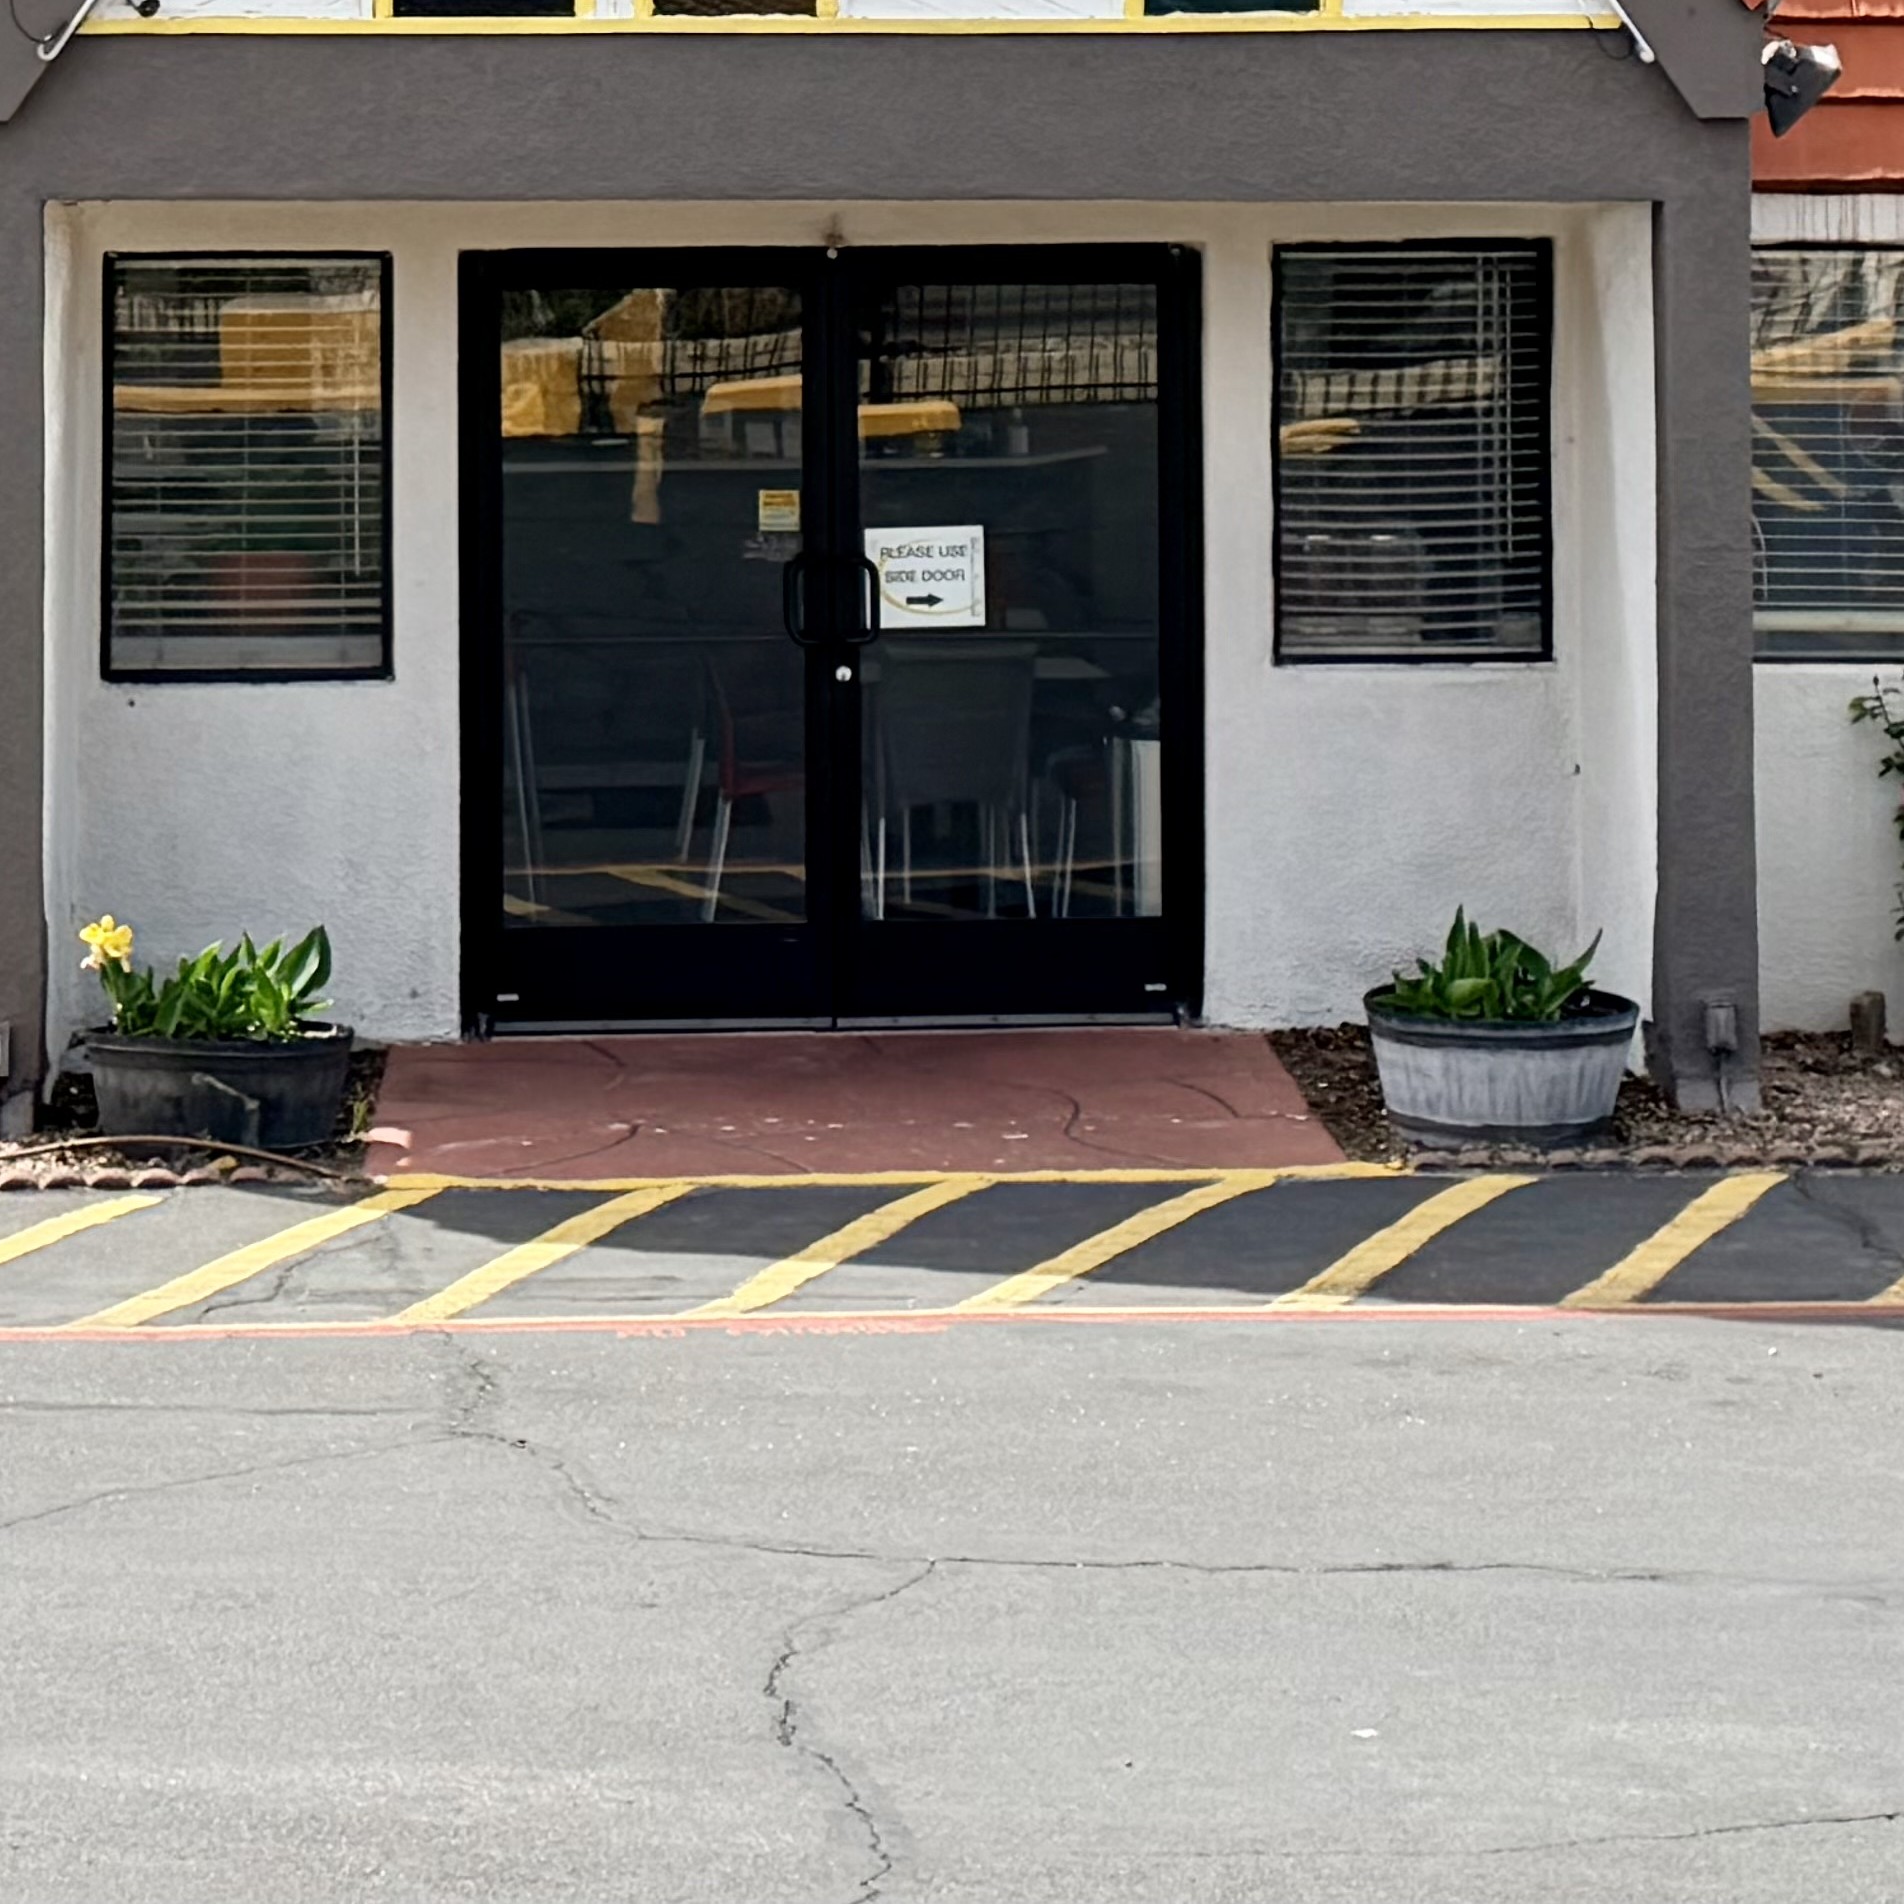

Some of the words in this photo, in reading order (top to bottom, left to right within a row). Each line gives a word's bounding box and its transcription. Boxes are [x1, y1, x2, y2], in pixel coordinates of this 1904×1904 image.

[880, 545, 934, 558] PLEASE
[939, 545, 967, 557] USE
[885, 570, 917, 583] SIDE
[922, 569, 965, 582] DOOR
